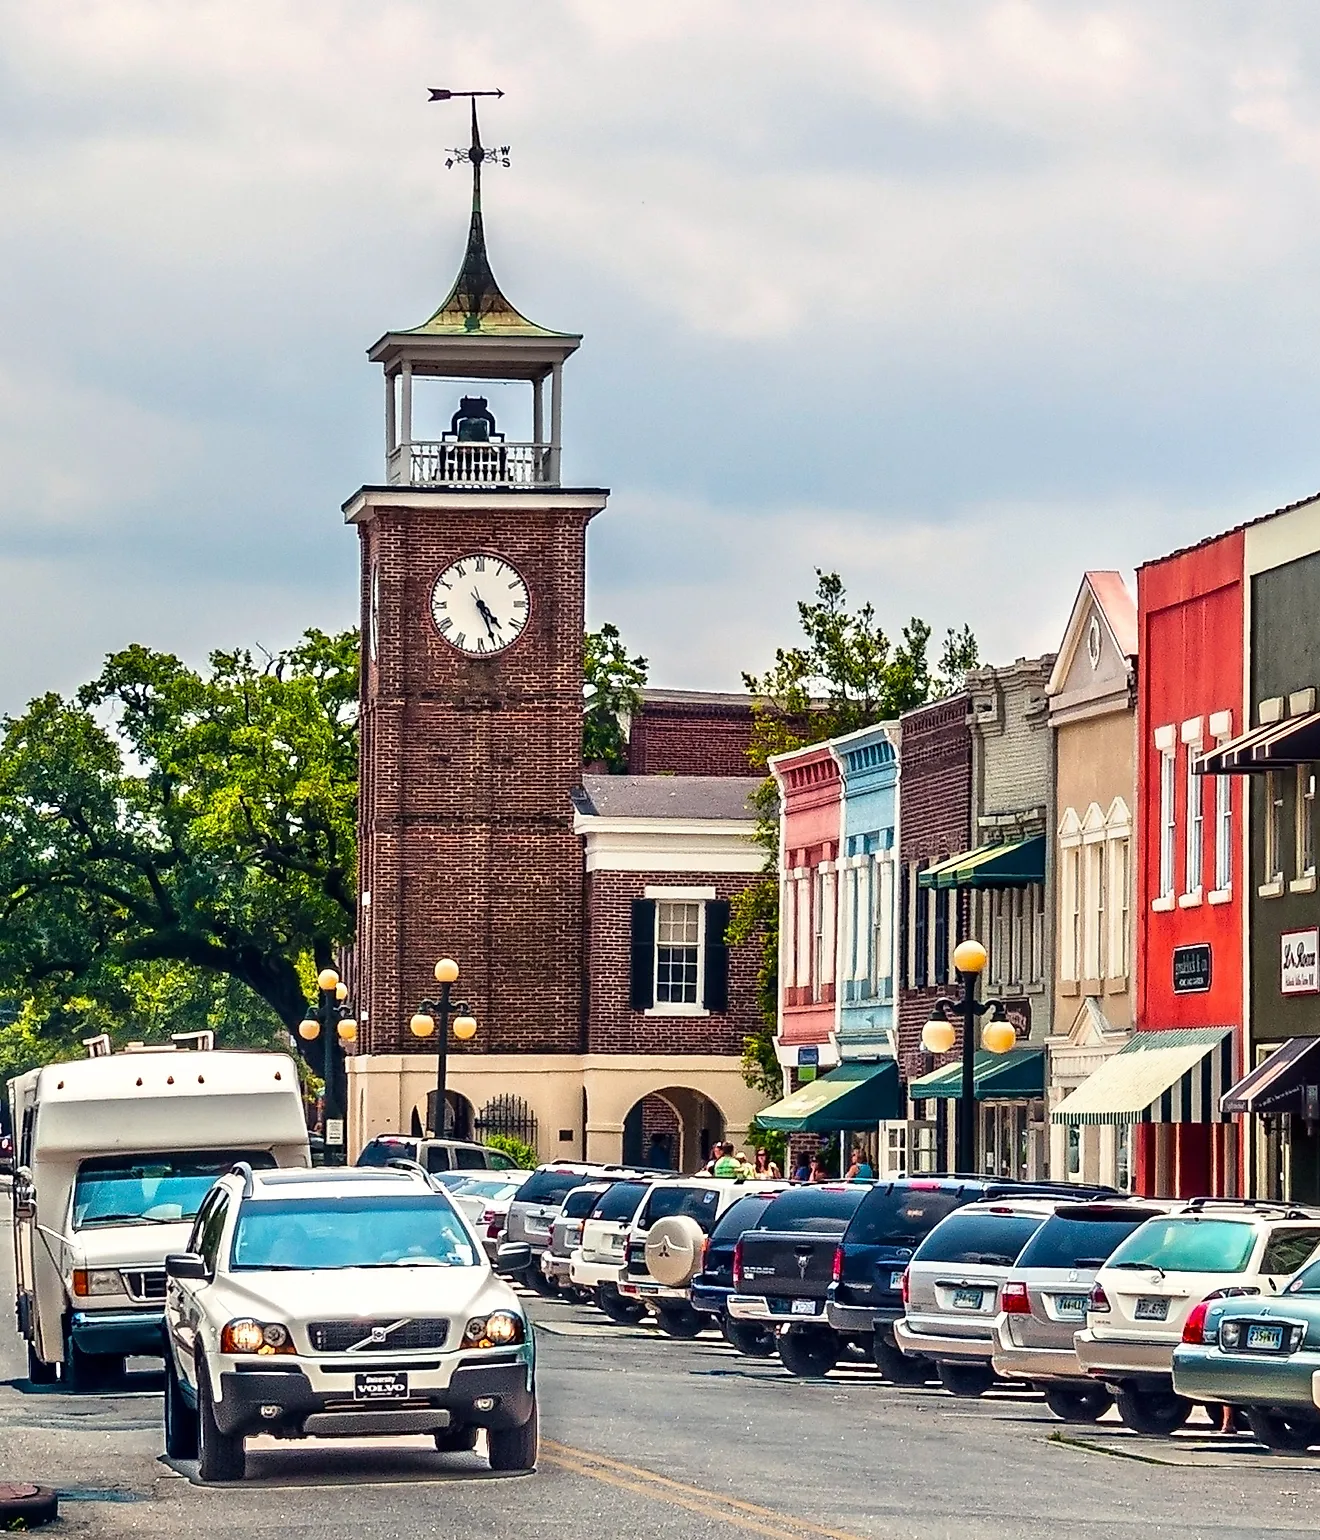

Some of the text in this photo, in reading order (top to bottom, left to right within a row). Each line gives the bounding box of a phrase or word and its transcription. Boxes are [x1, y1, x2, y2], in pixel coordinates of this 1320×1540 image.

[500, 146, 511, 156] W
[502, 157, 511, 168] S
[357, 1384, 406, 1393] VOLVO
